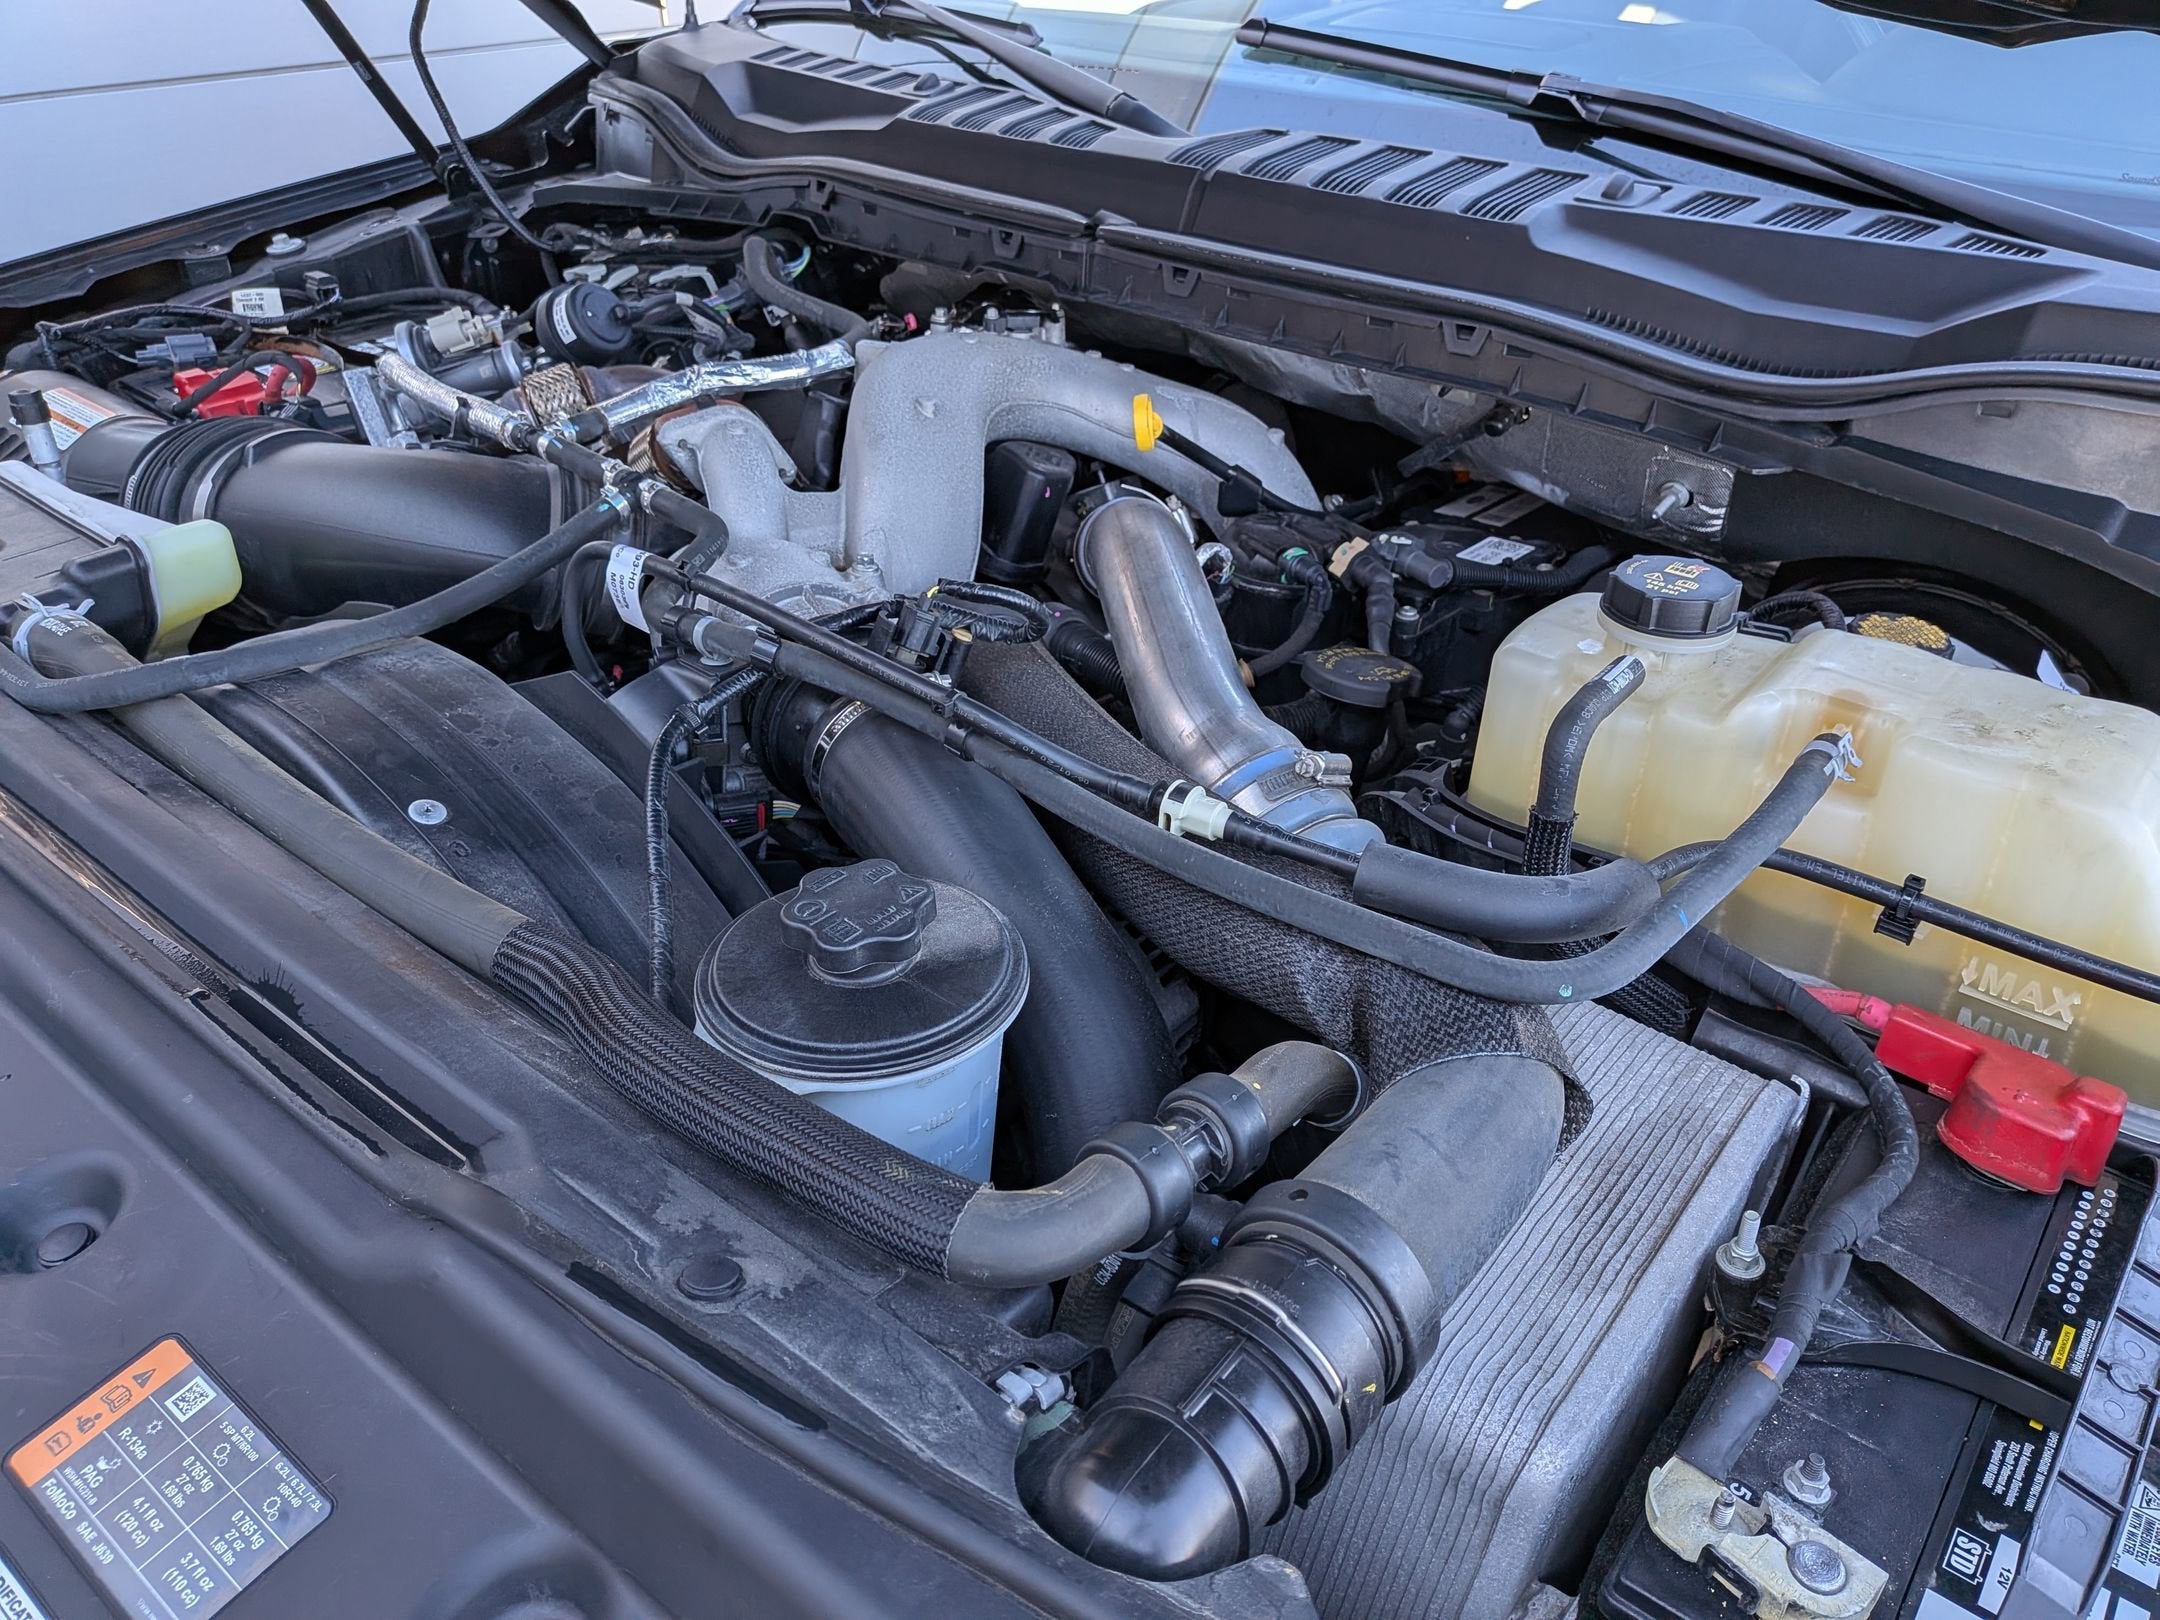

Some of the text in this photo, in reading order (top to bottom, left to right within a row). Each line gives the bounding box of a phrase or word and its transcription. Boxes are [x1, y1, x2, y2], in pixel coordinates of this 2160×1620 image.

[1976, 958, 2083, 1027] MAX
[2074, 1327, 2093, 1362] RECOMMENDED
[118, 1427, 146, 1459] R-134a
[223, 1425, 235, 1434] SP
[240, 1425, 255, 1441] 6.2L
[79, 1464, 103, 1488] PAG
[182, 1455, 214, 1492] 0.765 kg
[2037, 1446, 2054, 1474] CHARGING
[160, 1480, 185, 1507] 1.69 lbs
[175, 1472, 195, 1494] 27 oz
[274, 1461, 290, 1478] 6.2L
[290, 1478, 306, 1495] 6.7L
[306, 1494, 322, 1512] 7.3L
[277, 1482, 302, 1507] 10R140
[1729, 1482, 1752, 1501] 5
[41, 1478, 113, 1564] FoMoCo SAE J639
[113, 1509, 150, 1548] (120 cc)
[133, 1496, 164, 1532] 4.1 fl oz
[231, 1510, 264, 1549] 0.765 kg
[224, 1528, 245, 1551] 27 oz
[2121, 1510, 2144, 1557] WITH WATER.
[2133, 1516, 2157, 1566] IMMEDIATELY
[209, 1536, 235, 1566] 1.69 lbs
[1948, 1536, 1982, 1574] STD
[2147, 1545, 2160, 1565] EYES
[161, 1567, 200, 1608] (110 cc)
[180, 1552, 214, 1591] 3.7 fl oz
[1994, 1565, 2013, 1590] 12V
